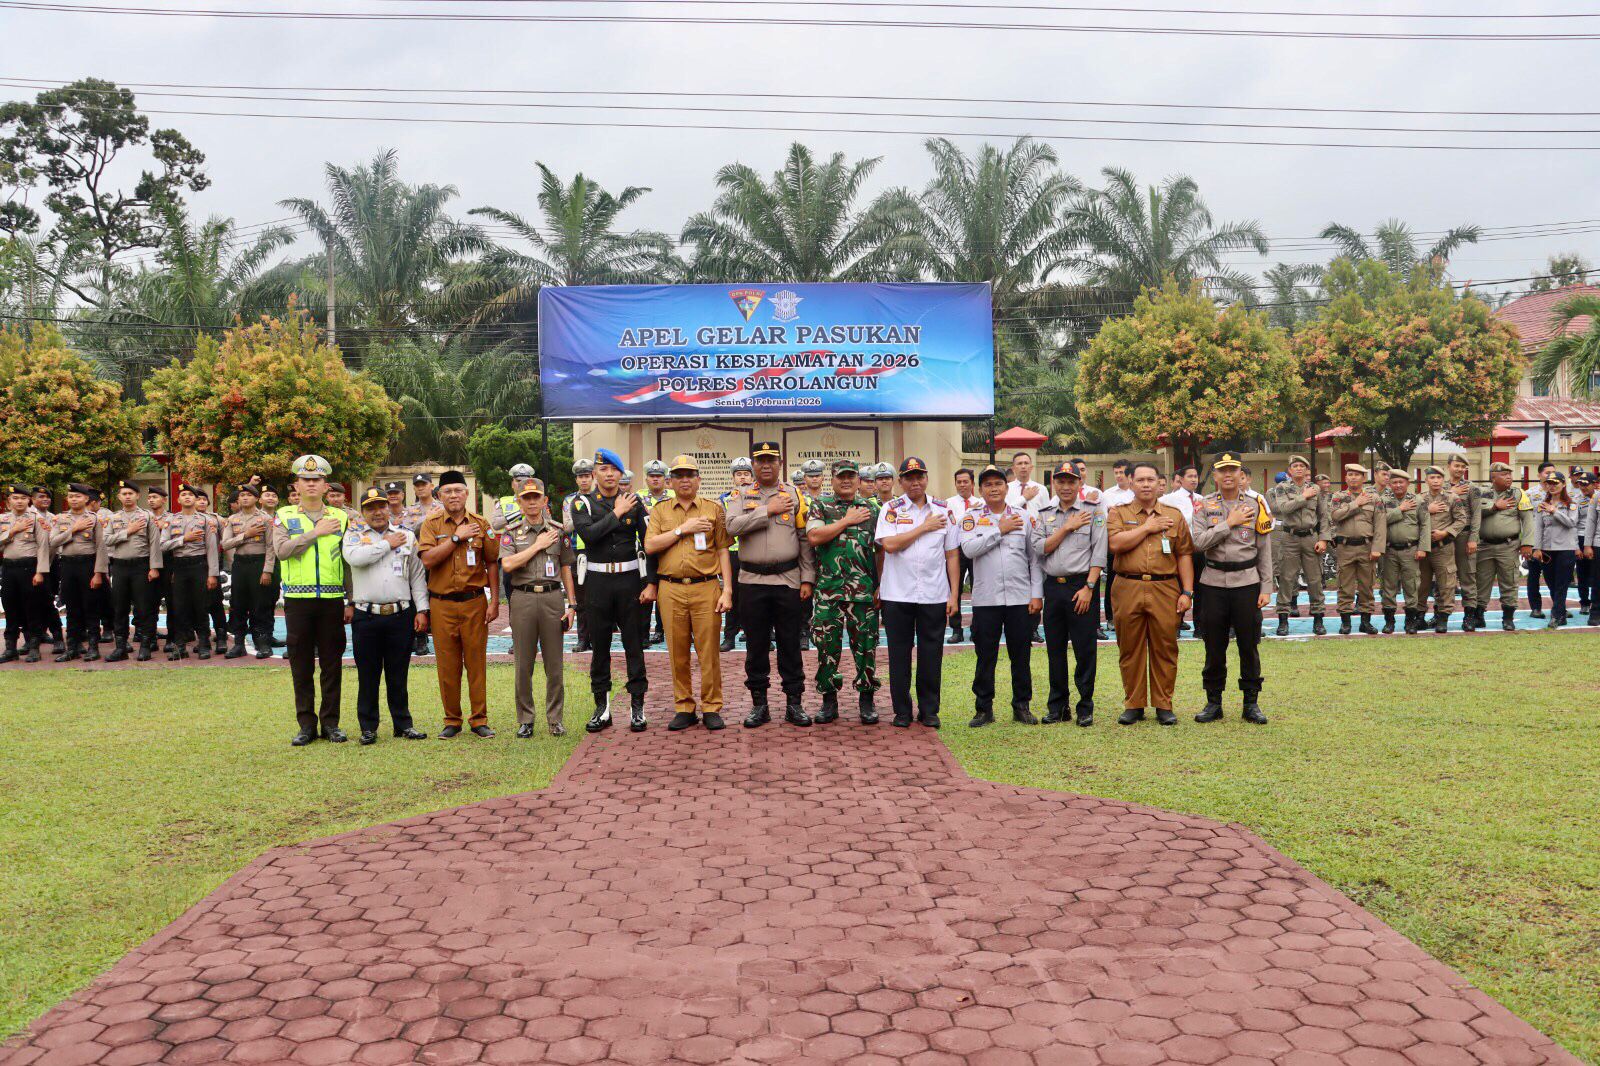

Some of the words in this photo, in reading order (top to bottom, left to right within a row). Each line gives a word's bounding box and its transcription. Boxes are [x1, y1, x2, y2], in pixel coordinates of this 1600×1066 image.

[618, 328, 688, 347] APEL
[696, 326, 787, 345] GELAR
[796, 325, 921, 344] PASUKAN
[621, 355, 709, 370] OPERASI
[715, 353, 864, 369] KESELAMATAN
[871, 353, 920, 368] 2026
[658, 377, 737, 392] POLRES
[743, 375, 879, 390] SAROLANGUN
[715, 398, 744, 408] Senin,
[746, 398, 753, 406] 2
[755, 397, 794, 406] Februari
[797, 397, 821, 406] 2026
[824, 450, 861, 458] PRASETYA
